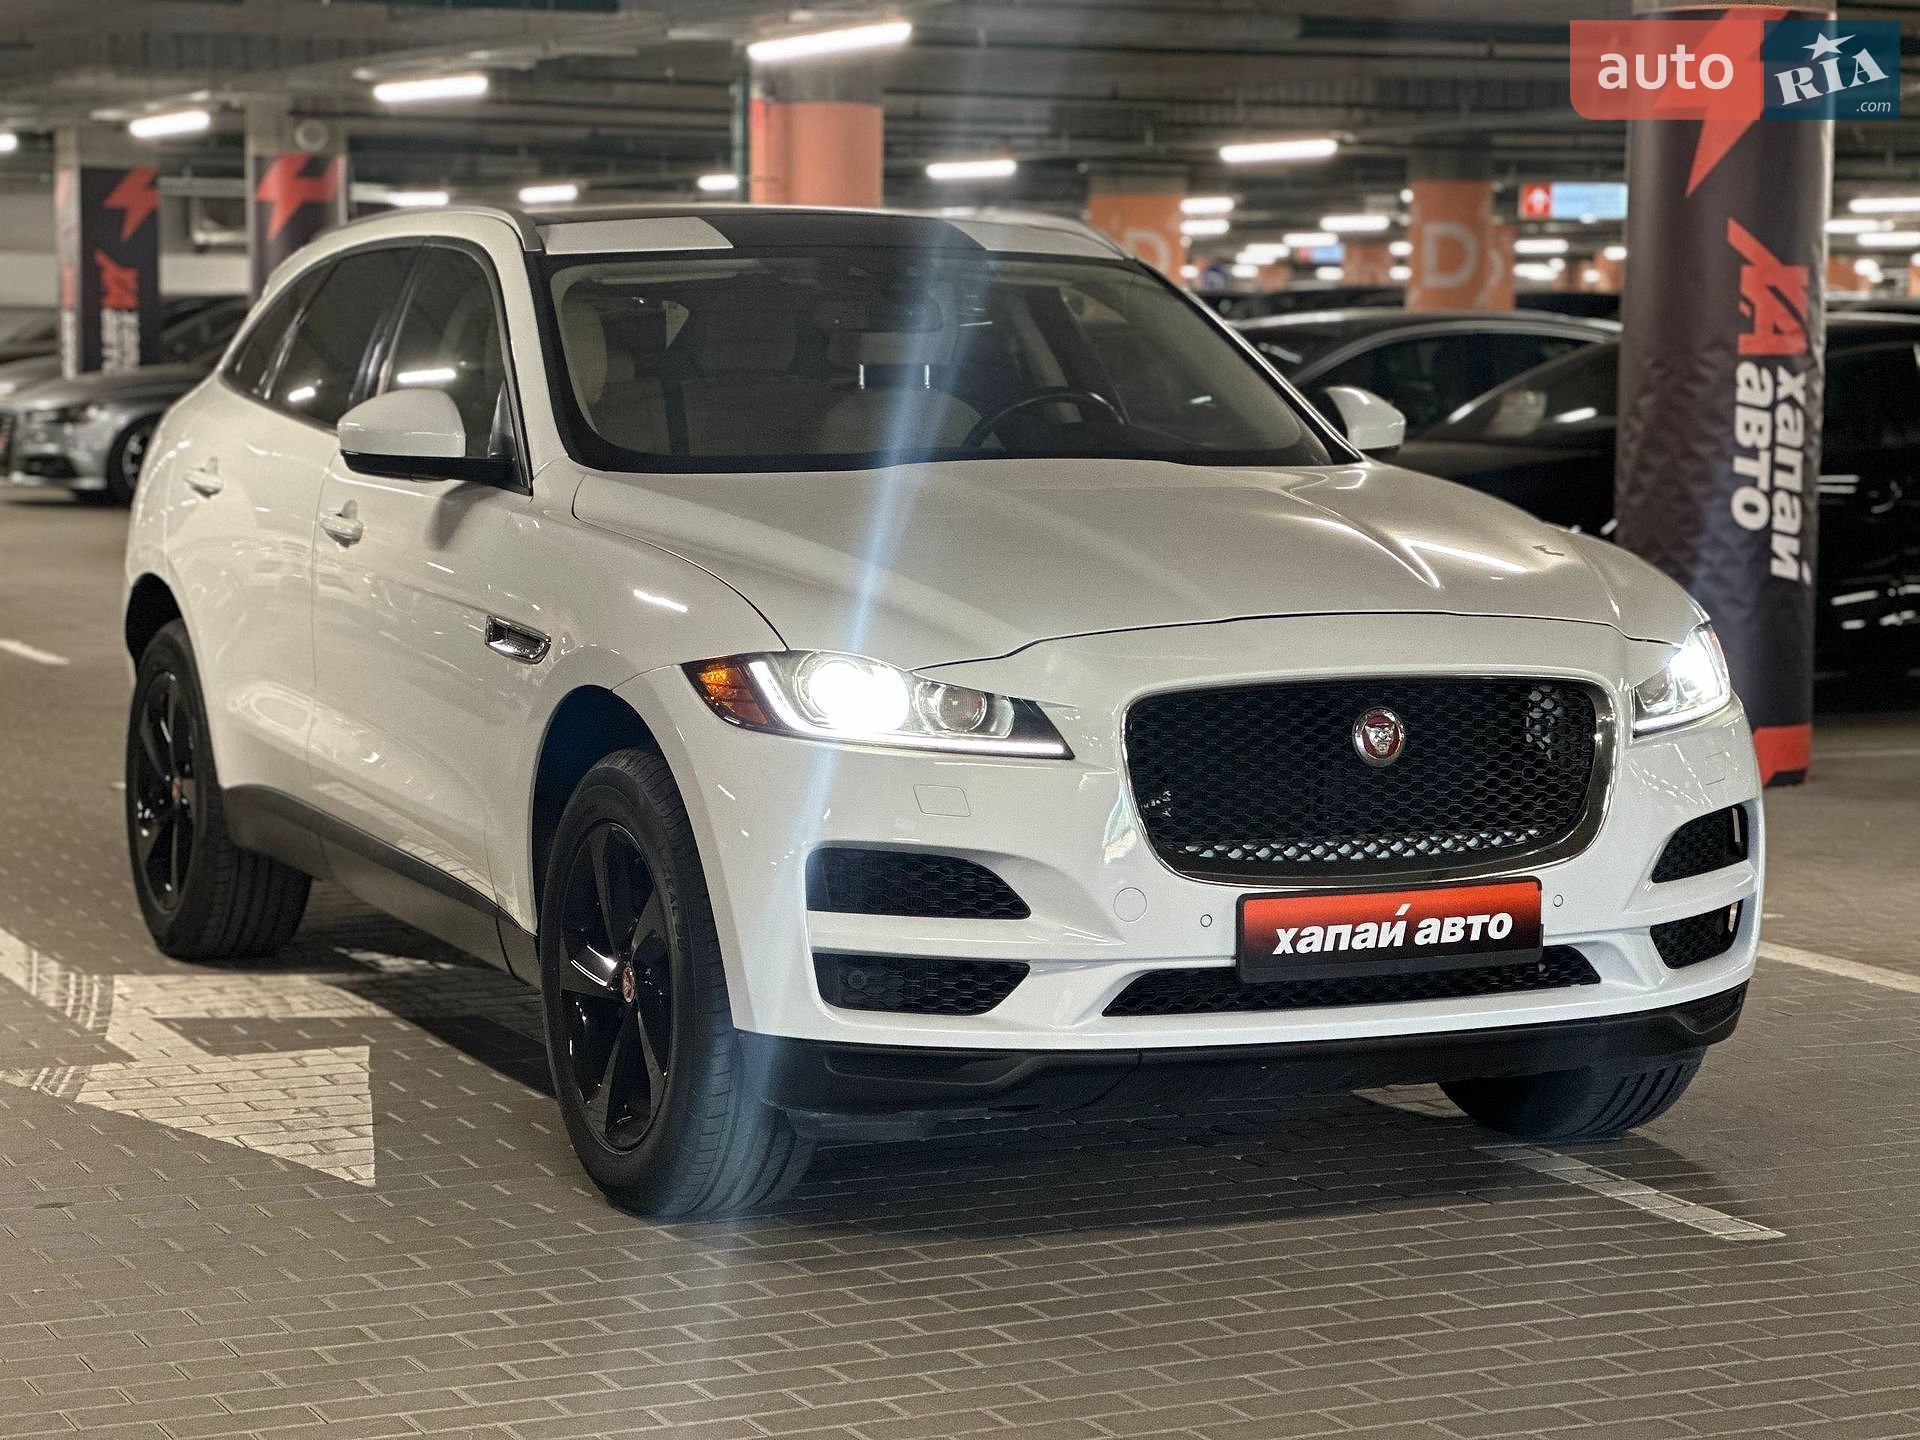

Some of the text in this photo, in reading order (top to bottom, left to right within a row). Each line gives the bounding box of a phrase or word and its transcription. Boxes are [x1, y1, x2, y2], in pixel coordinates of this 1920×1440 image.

[1420, 220, 1480, 289] D
[1730, 360, 1773, 531] авто
[1413, 911, 1514, 945] авто
